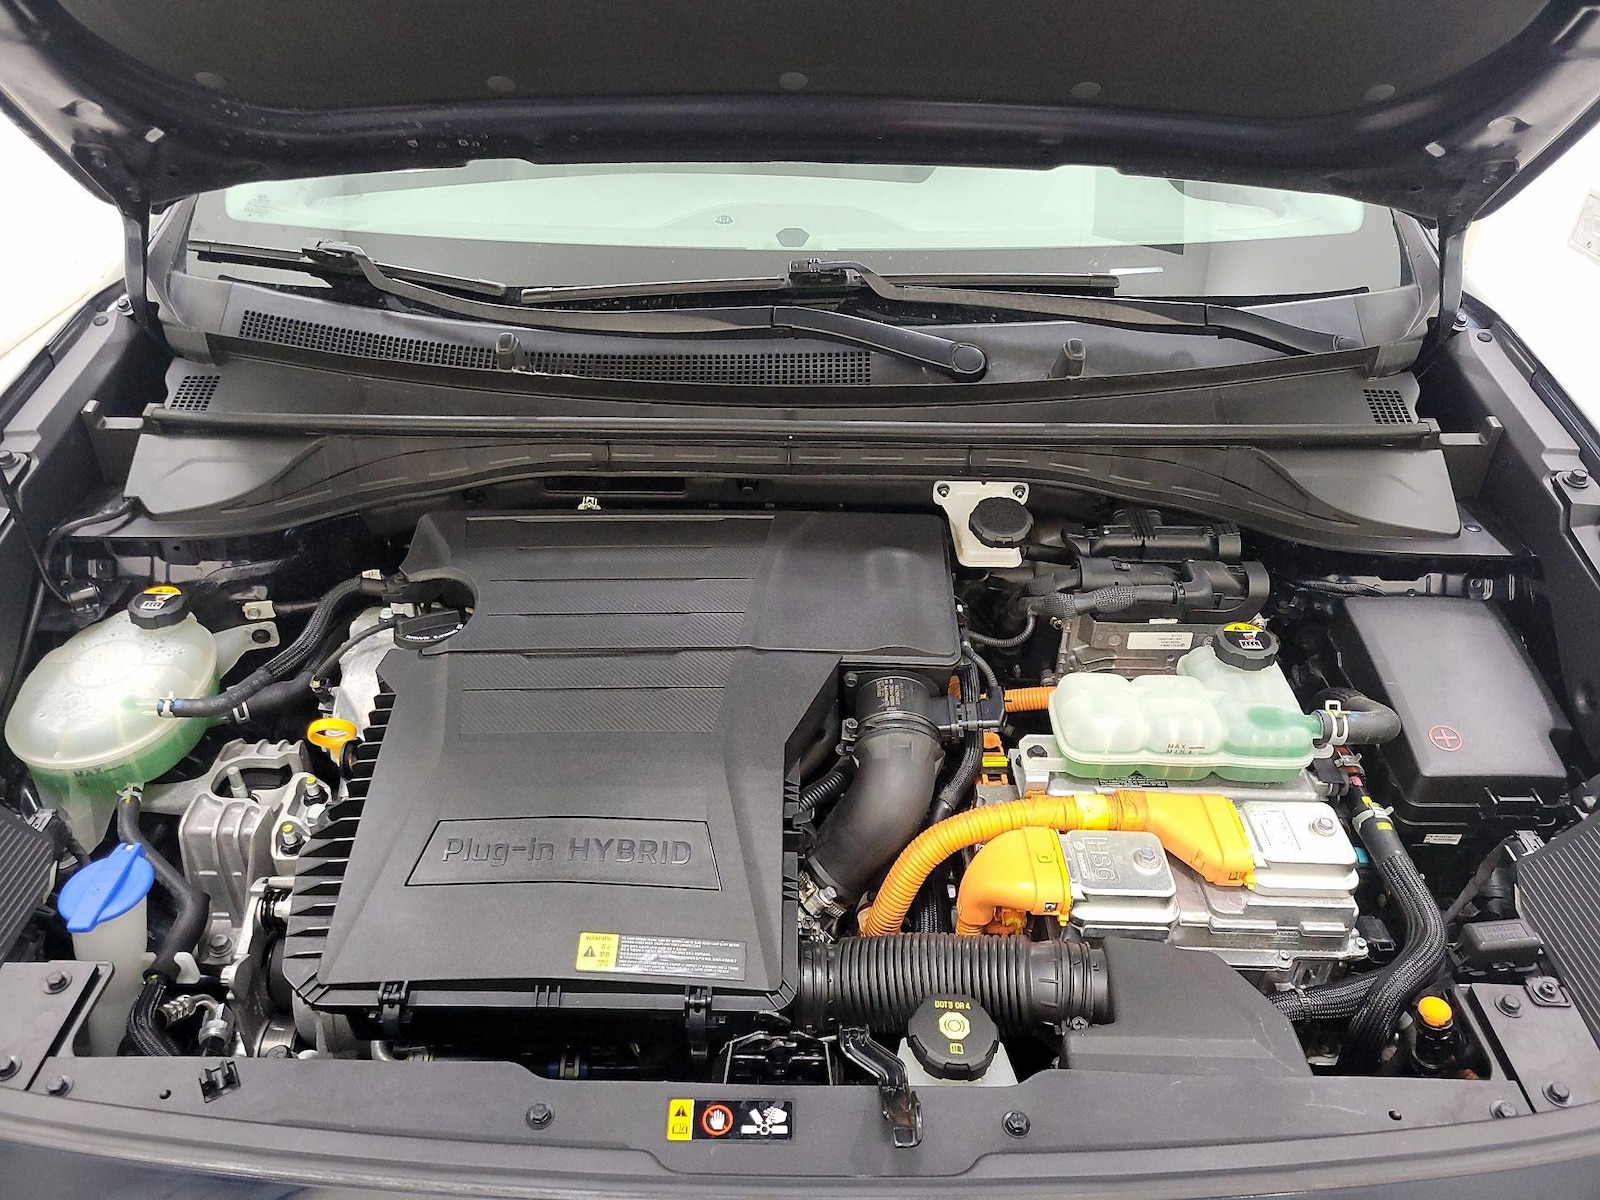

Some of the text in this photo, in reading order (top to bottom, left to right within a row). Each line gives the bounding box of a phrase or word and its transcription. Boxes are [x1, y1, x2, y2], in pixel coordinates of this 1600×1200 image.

[73, 767, 101, 778] MAX
[441, 837, 693, 867] Plug-in HYBRID
[1087, 841, 1117, 881] HSG
[954, 1001, 965, 1010] OR
[965, 1002, 971, 1010] 4
